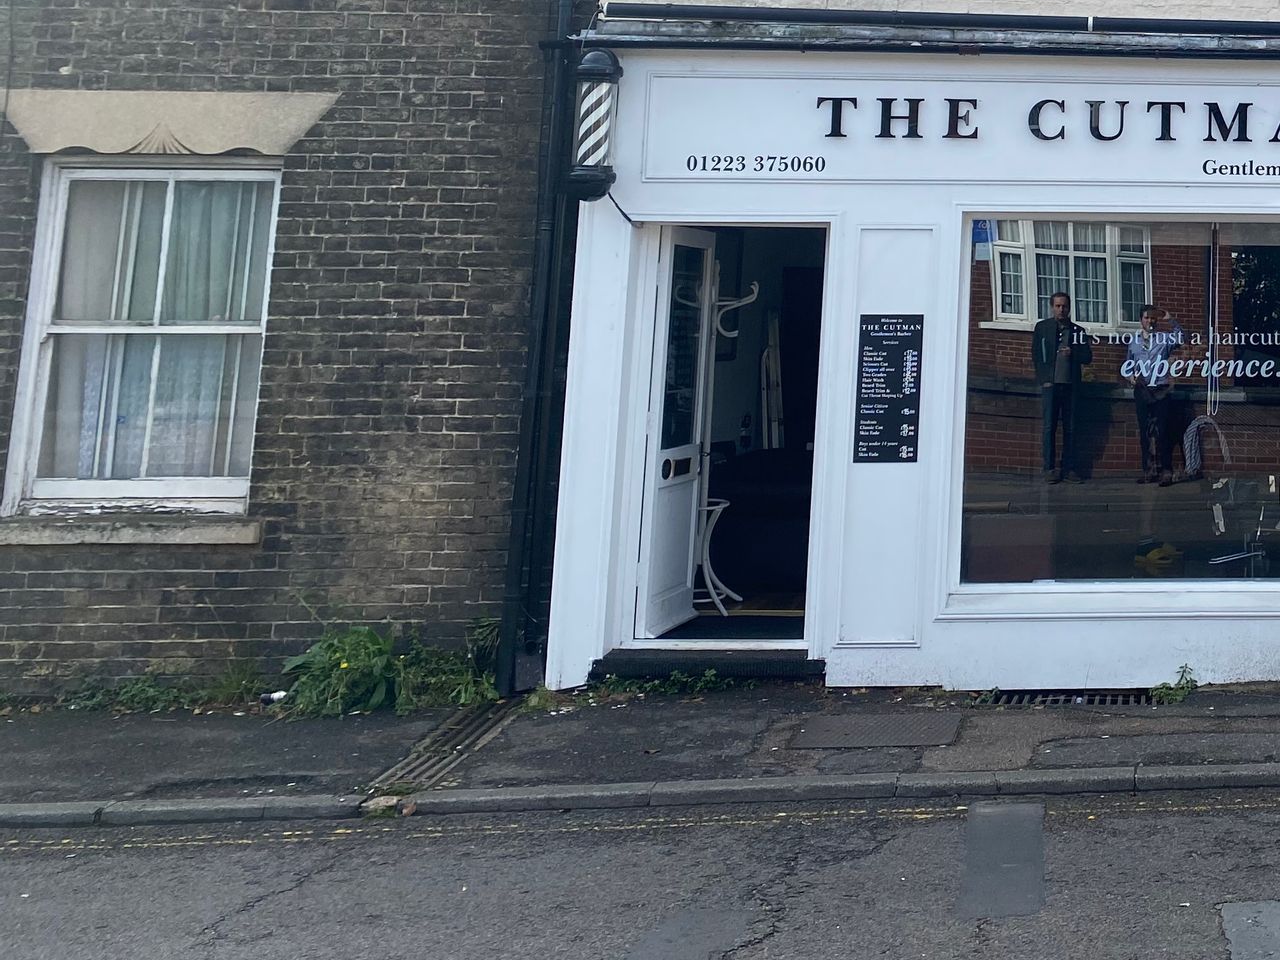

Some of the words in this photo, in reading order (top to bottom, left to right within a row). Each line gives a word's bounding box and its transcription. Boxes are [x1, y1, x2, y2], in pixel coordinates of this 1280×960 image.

[816, 96, 979, 140] THE
[686, 155, 746, 172] 01223
[753, 155, 826, 173] 375060
[1072, 326, 1101, 345] it's
[1108, 330, 1141, 345] not
[1147, 326, 1185, 349] just
[1190, 331, 1202, 345] a
